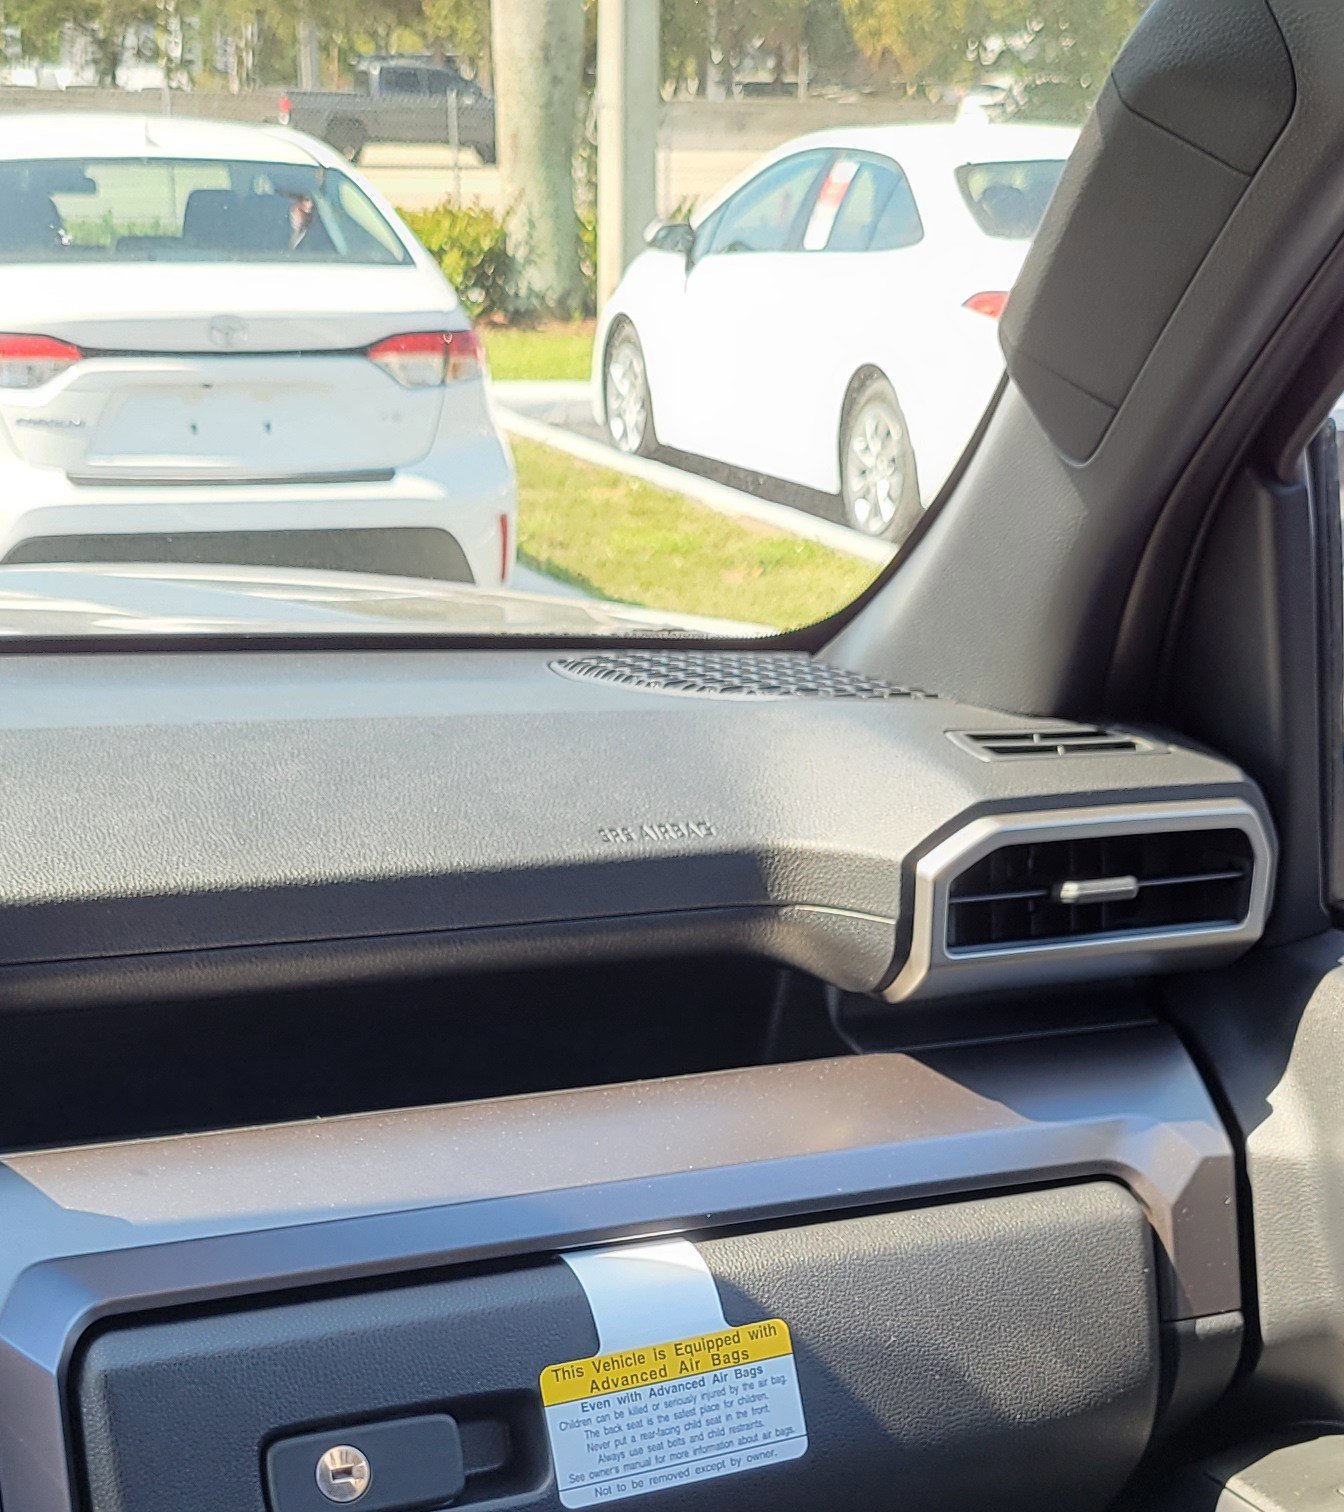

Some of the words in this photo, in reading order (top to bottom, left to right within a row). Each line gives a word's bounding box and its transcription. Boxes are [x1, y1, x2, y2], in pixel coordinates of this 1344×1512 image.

[641, 821, 717, 841] AIRBAG
[551, 1365, 584, 1382] This
[592, 1352, 646, 1374] Vehicle
[653, 1347, 667, 1361] is
[674, 1330, 741, 1357] Equipped
[748, 1323, 777, 1340] with
[590, 1364, 668, 1393] Advanced
[679, 1358, 701, 1374] Air
[711, 1348, 750, 1367] Bags
[559, 1417, 592, 1431] Children
[596, 1414, 610, 1423] can
[614, 1410, 624, 1419] be
[652, 1402, 660, 1411] or
[729, 1385, 739, 1395] by
[742, 1381, 754, 1391] the
[758, 1378, 768, 1388] air
[581, 1399, 611, 1413] Even
[617, 1391, 643, 1405] with
[649, 1376, 706, 1398] Advanced
[712, 1372, 729, 1386] Air
[734, 1365, 764, 1380] Bags
[584, 1429, 600, 1440] The
[604, 1424, 623, 1435] back
[626, 1420, 644, 1430] seat
[657, 1414, 670, 1423] the
[724, 1399, 734, 1408] for
[586, 1440, 610, 1453] Never
[615, 1436, 627, 1448] put
[631, 1434, 637, 1442] a
[684, 1419, 702, 1431] child
[705, 1415, 722, 1427] seat
[725, 1413, 733, 1421] in
[736, 1409, 748, 1418] the
[568, 1473, 586, 1484] See
[623, 1457, 652, 1472] manual
[655, 1454, 666, 1464] for
[669, 1450, 689, 1461] more
[693, 1440, 734, 1455] information
[737, 1433, 759, 1446] about
[762, 1430, 772, 1440] air
[598, 1450, 625, 1464] Always
[629, 1447, 644, 1457] use
[647, 1441, 665, 1453] seat
[689, 1432, 704, 1443] and
[707, 1427, 725, 1439] child
[594, 1486, 613, 1498] Not
[616, 1483, 627, 1492] to
[631, 1479, 644, 1490] be
[649, 1467, 690, 1486] removed
[695, 1460, 726, 1475] except
[730, 1457, 742, 1467] by
[746, 1449, 778, 1463] owner.
